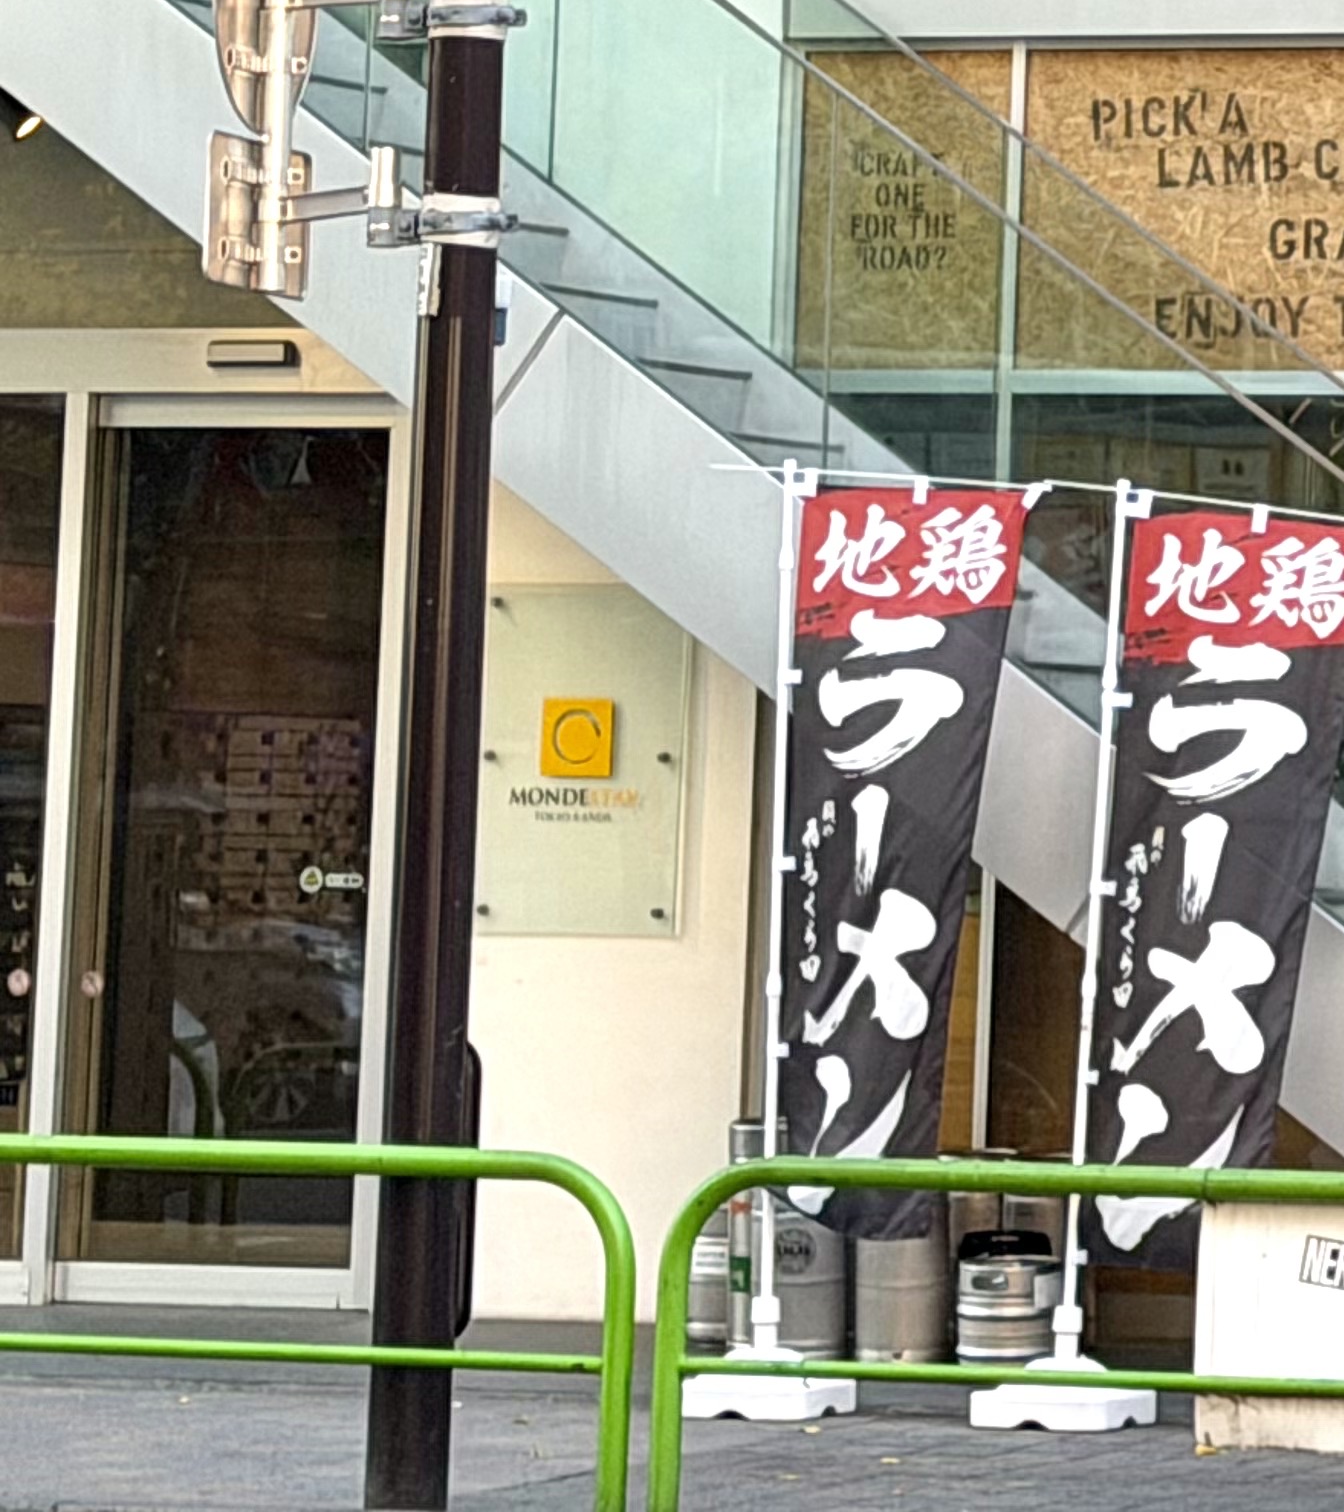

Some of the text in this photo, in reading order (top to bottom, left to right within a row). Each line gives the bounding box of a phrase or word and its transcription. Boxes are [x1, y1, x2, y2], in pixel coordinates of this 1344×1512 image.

[1092, 93, 1248, 140] PICK A
[1158, 141, 1289, 188] LAMB
[876, 183, 925, 212] ONE
[851, 212, 956, 239] FOR THE
[863, 245, 947, 270] ROAD?
[1154, 293, 1309, 339] ENJOY
[811, 504, 1007, 604] 地鶏
[787, 609, 965, 1217] ラーメン
[1094, 635, 1308, 1252] ラーメン
